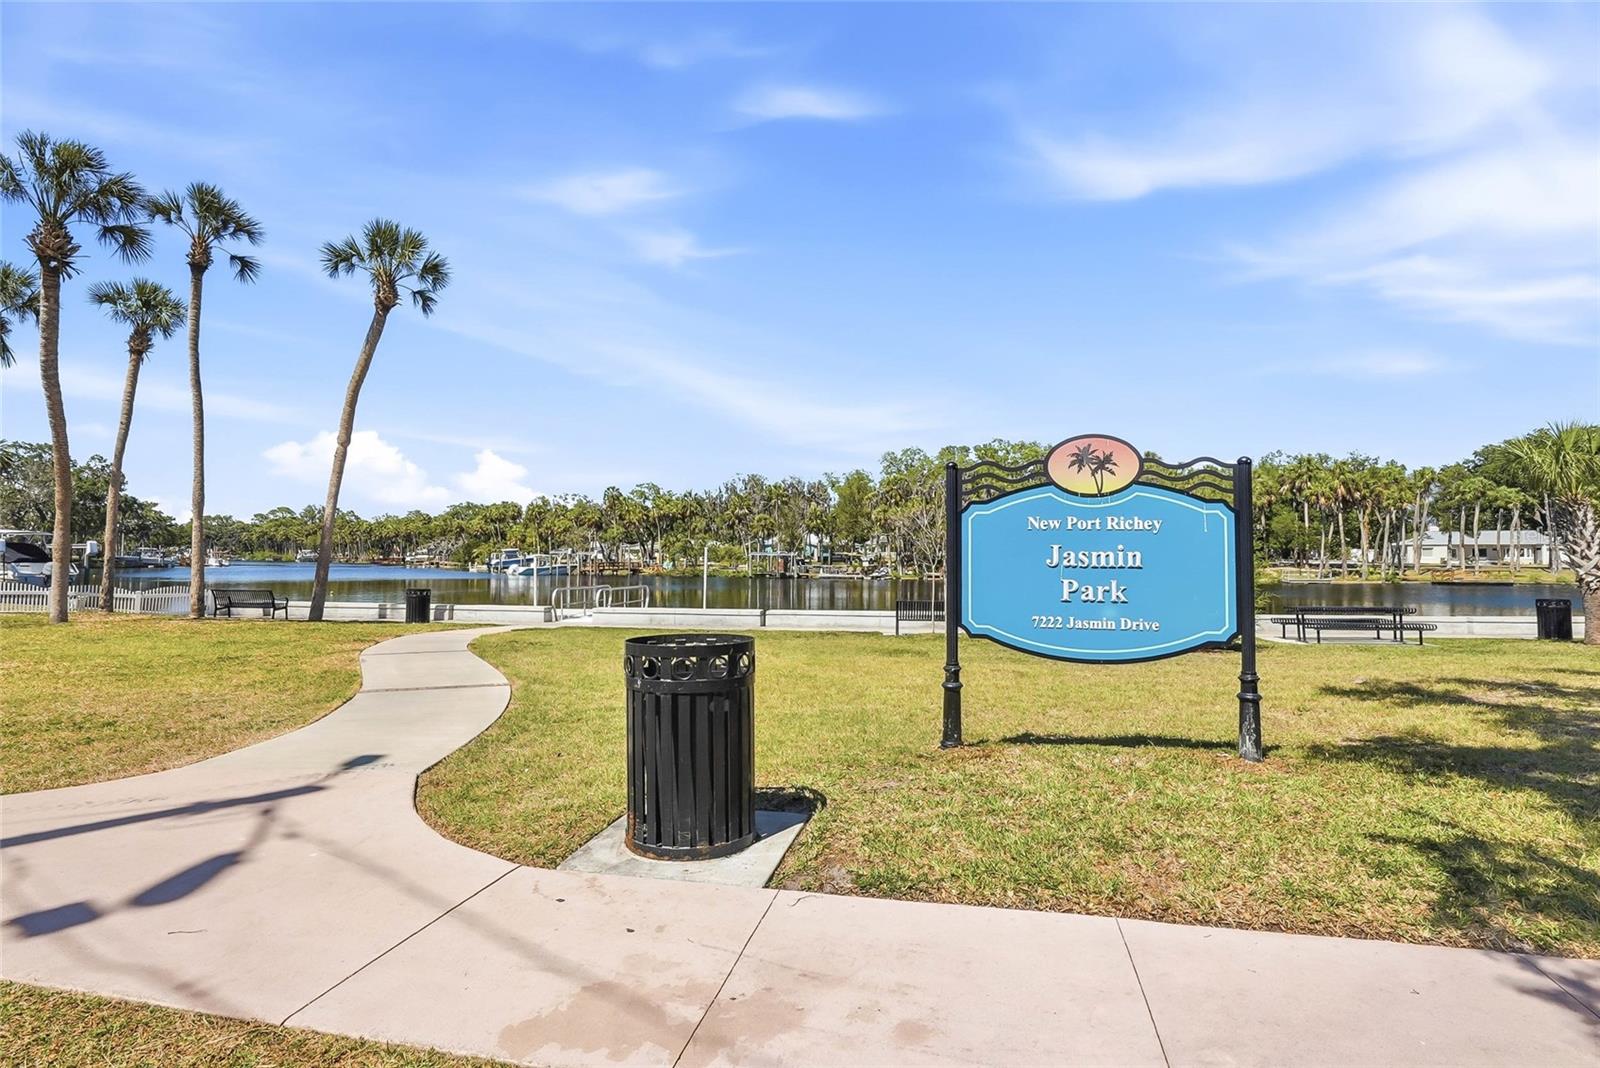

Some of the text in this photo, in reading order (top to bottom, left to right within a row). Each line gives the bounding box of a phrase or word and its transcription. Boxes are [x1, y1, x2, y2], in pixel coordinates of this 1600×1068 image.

[1027, 516, 1163, 535] New Port Richey
[1046, 544, 1143, 568] Jasmin
[1060, 578, 1128, 603] Park
[1031, 615, 1160, 631] 7222 Jasmin Drive
